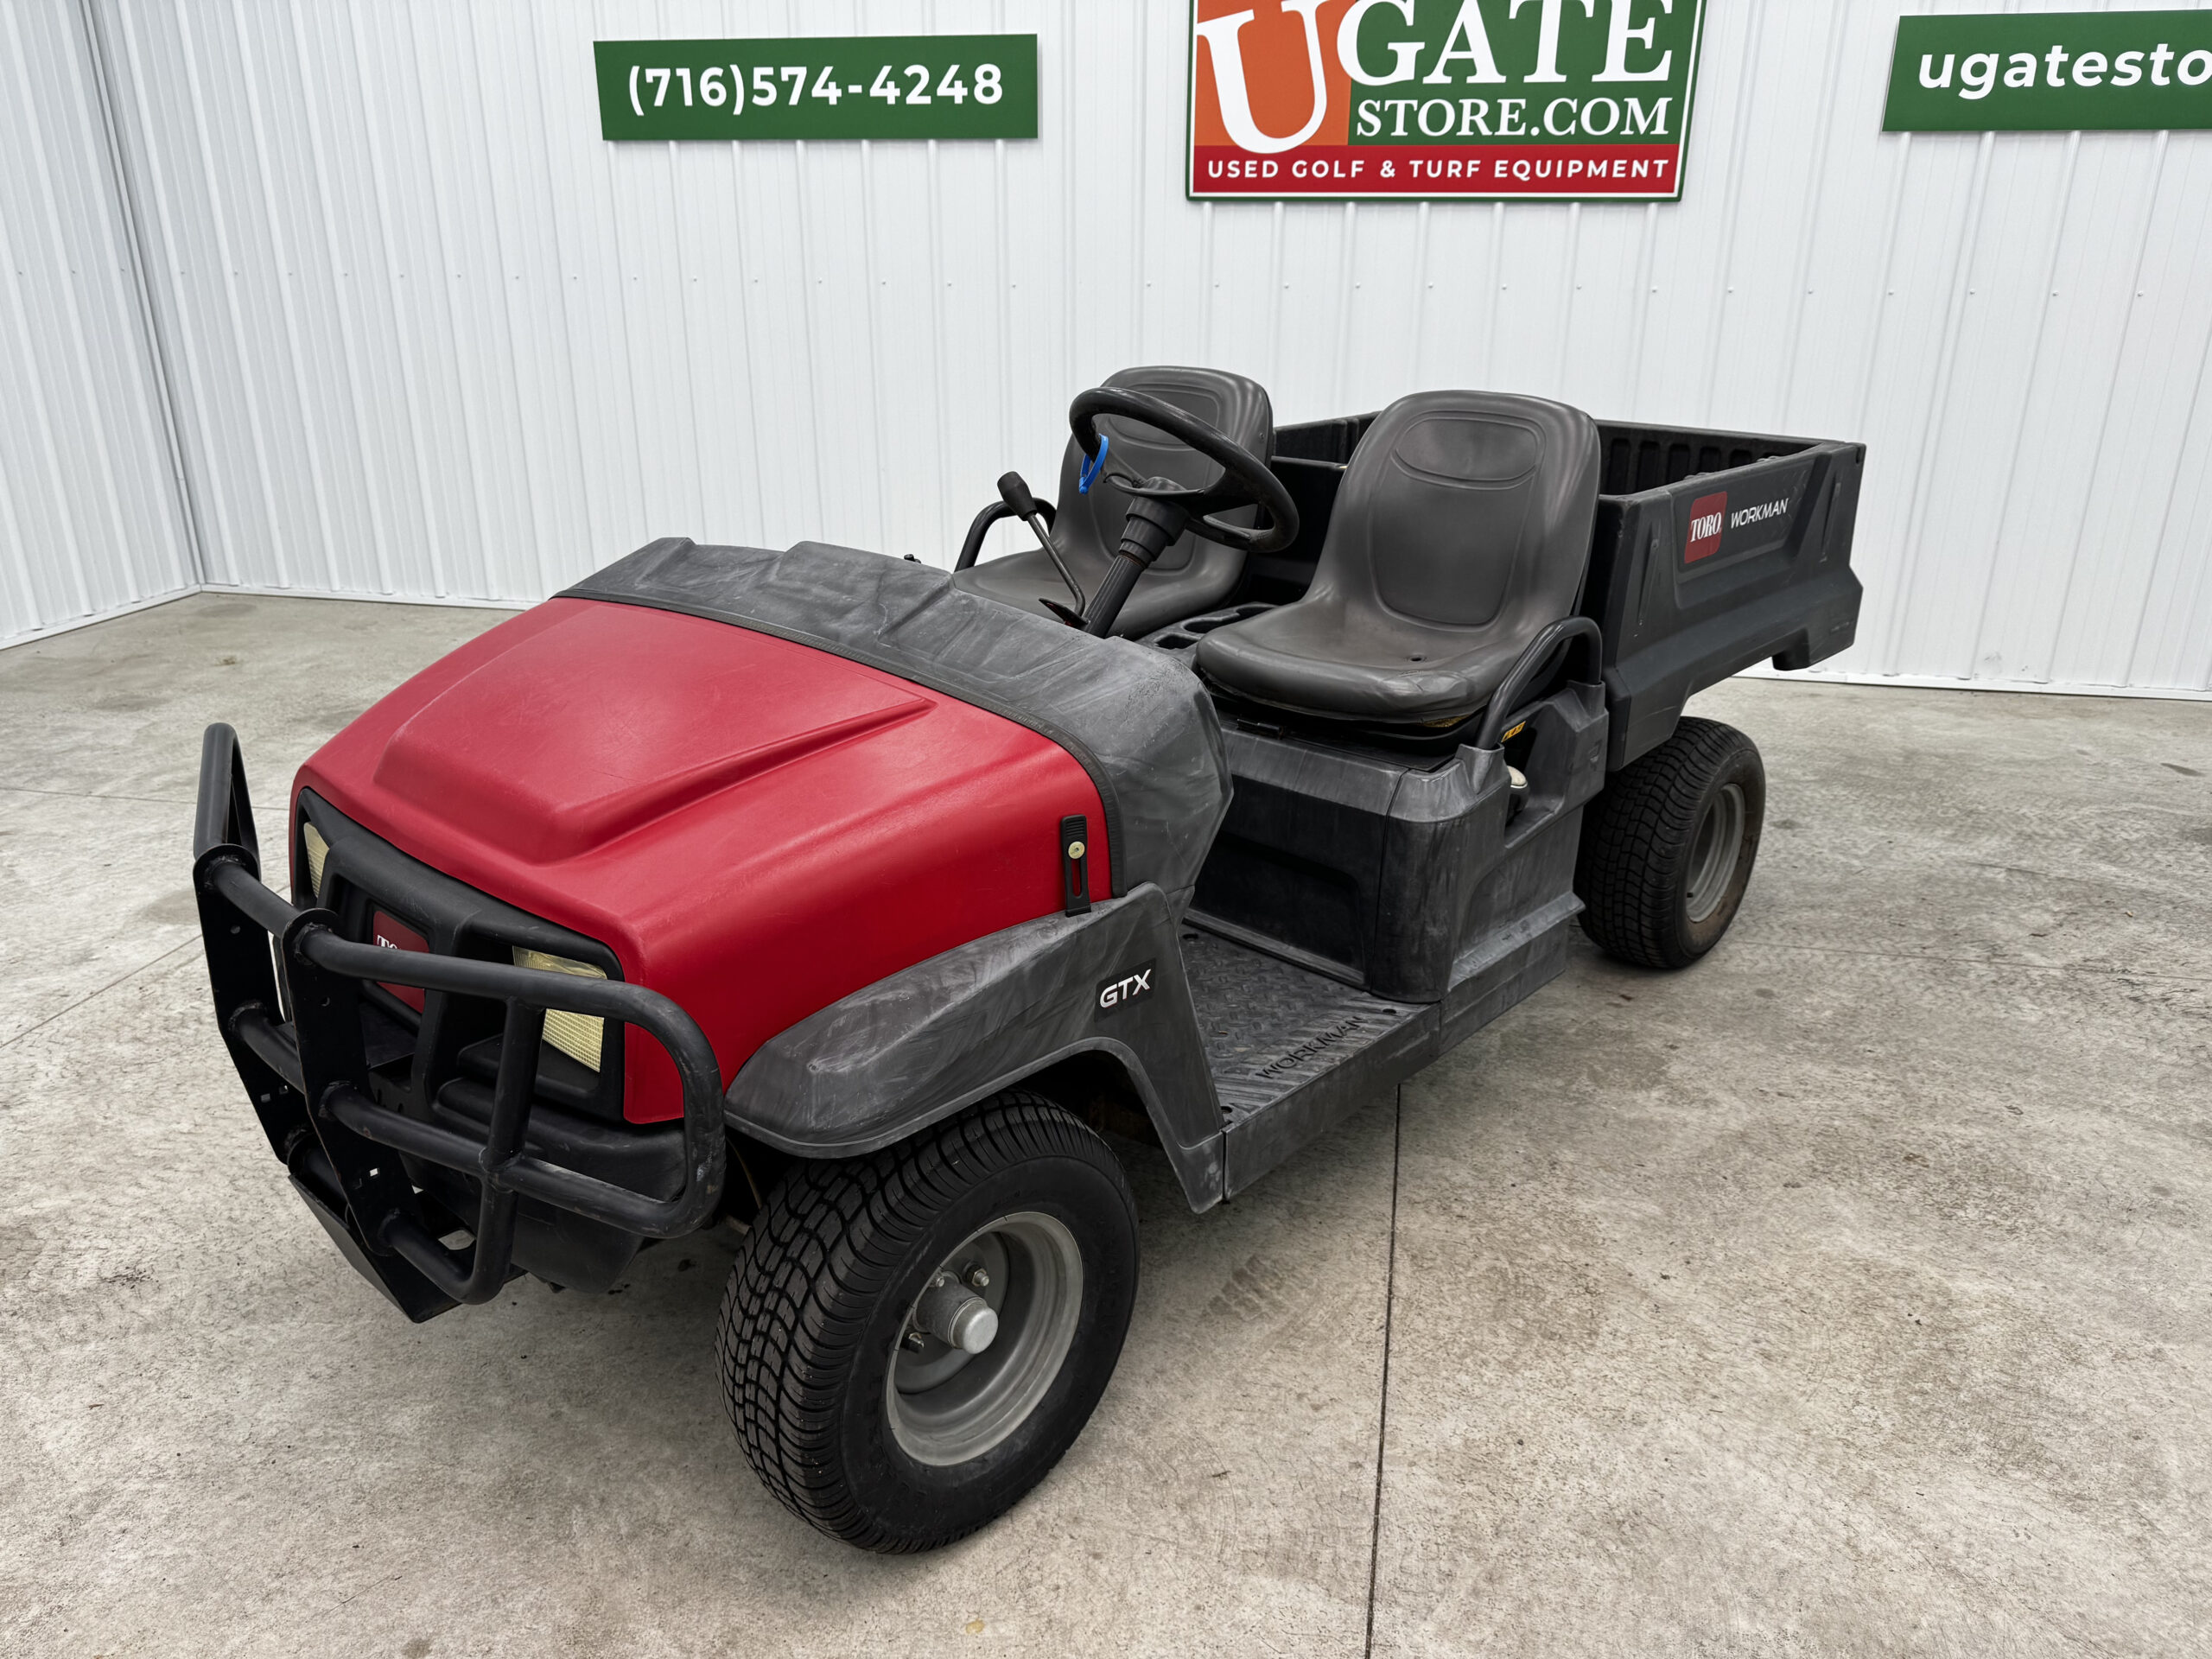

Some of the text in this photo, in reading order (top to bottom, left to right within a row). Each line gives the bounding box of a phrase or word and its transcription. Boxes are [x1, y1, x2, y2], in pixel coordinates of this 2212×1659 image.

[628, 64, 1003, 116] (716)574-4248
[1918, 43, 2212, 100] ugatesto
[1357, 97, 1673, 137] STORE.COM
[1208, 159, 1669, 181] USED GOLF & TURF EQUIPMENT
[1690, 498, 1789, 543] TORO WORKMAN
[1099, 969, 1152, 1008] GTX
[1255, 1015, 1370, 1079] WORKMAN
